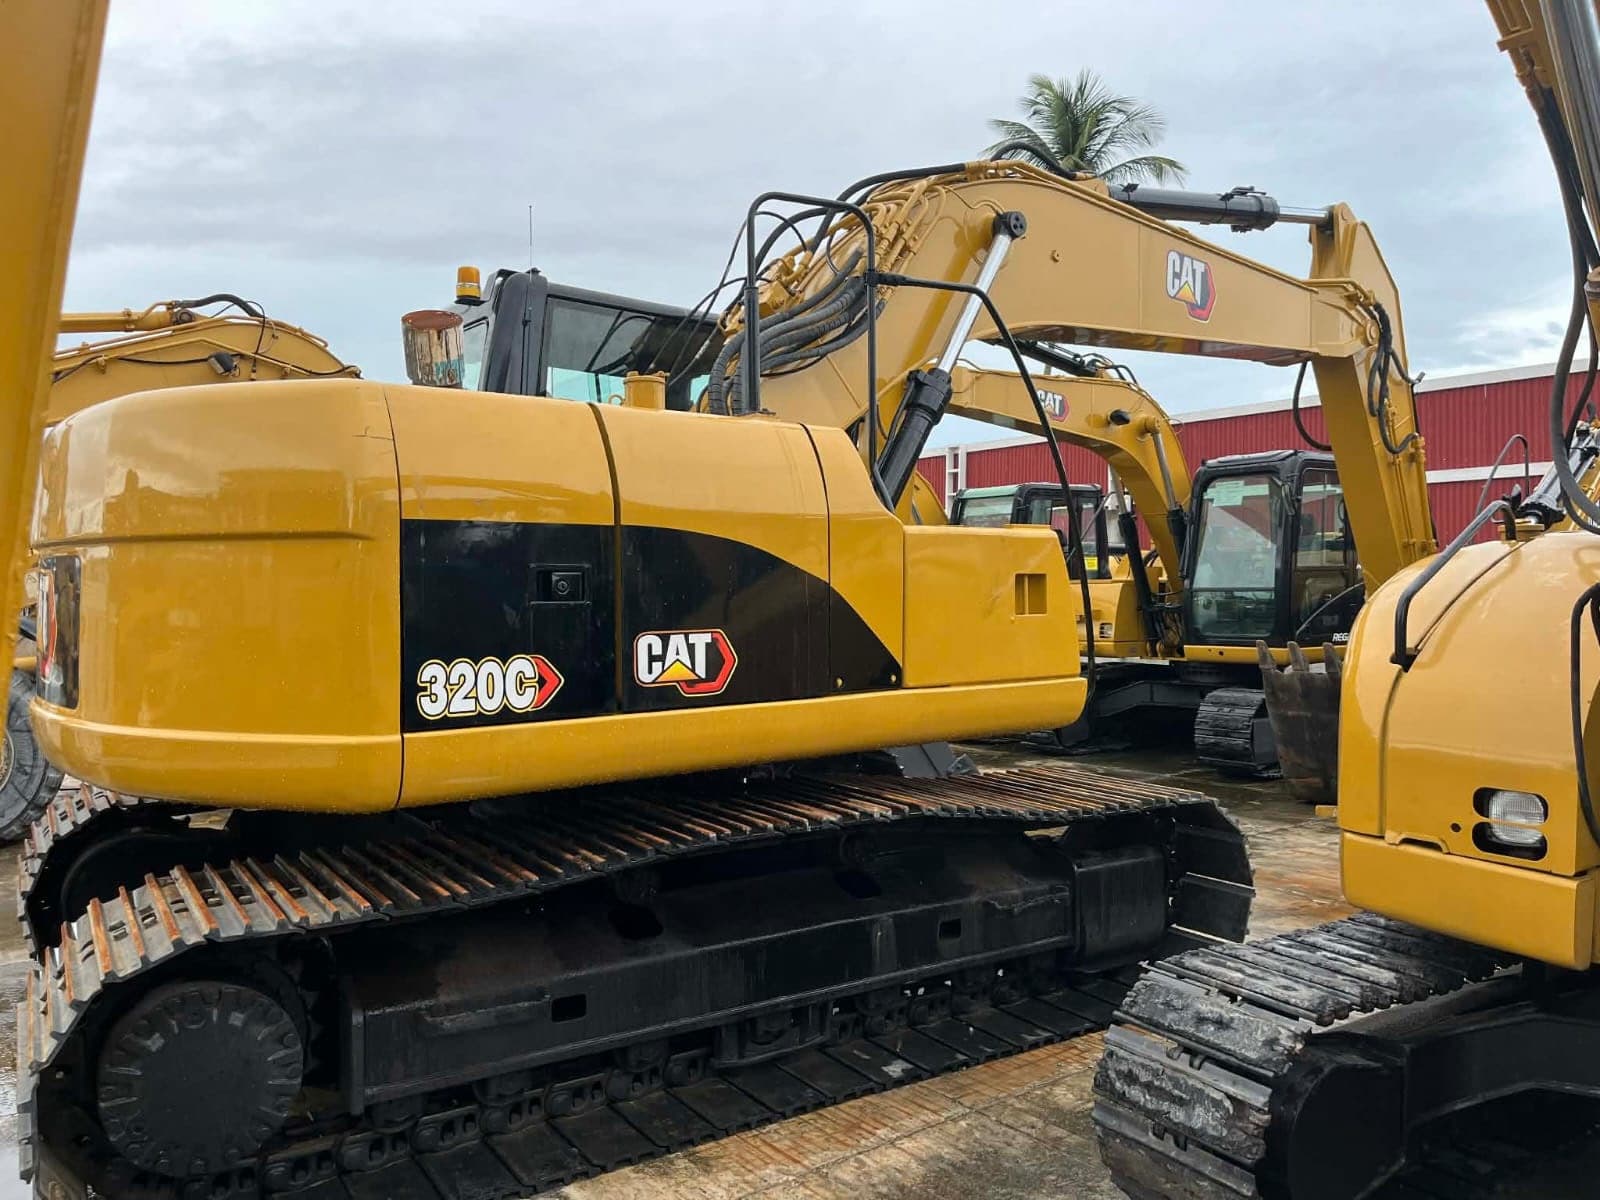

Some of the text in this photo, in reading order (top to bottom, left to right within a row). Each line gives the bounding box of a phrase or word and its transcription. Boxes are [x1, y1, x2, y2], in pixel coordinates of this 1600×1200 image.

[1166, 250, 1206, 307] CAT
[637, 632, 714, 684] CAT
[1332, 632, 1350, 642] REG
[417, 656, 539, 719] 320C
